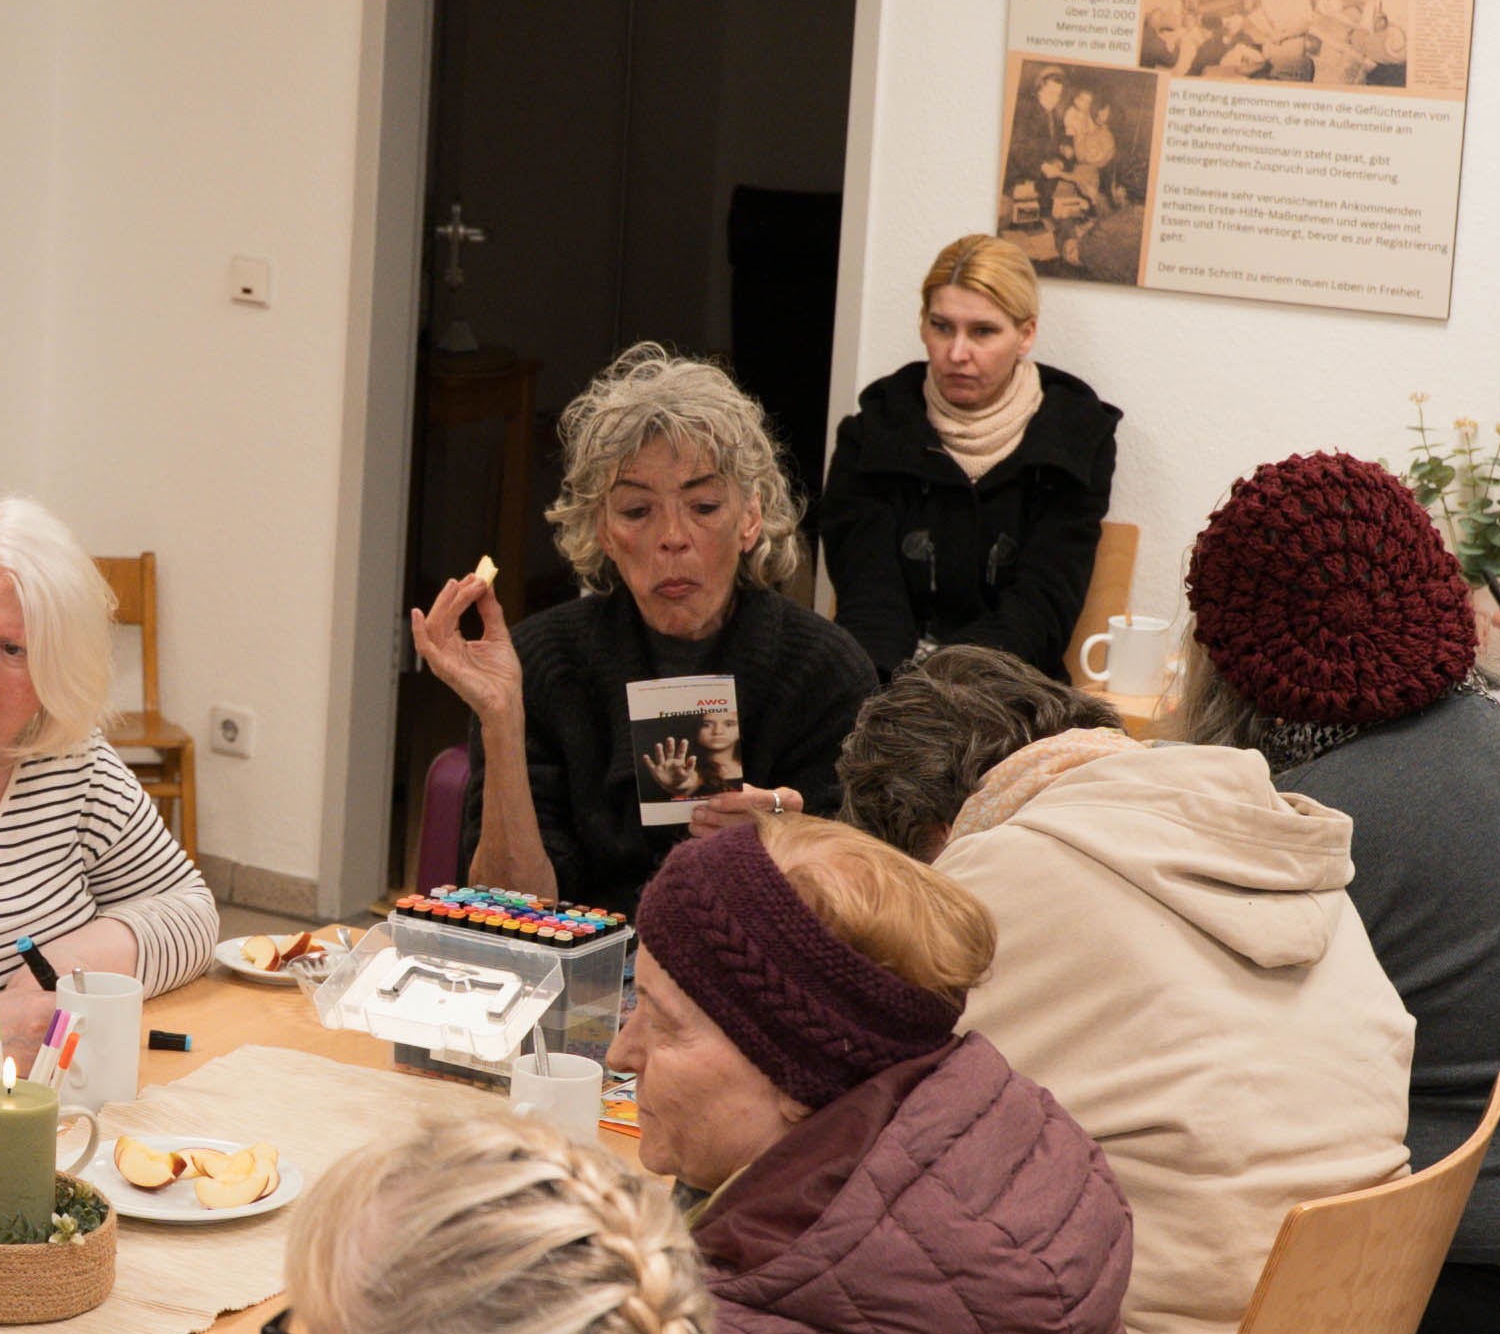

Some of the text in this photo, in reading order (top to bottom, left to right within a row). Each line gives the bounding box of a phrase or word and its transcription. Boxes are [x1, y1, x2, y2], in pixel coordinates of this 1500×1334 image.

[1157, 261, 1423, 299] Der erste Schritt zu einem neuen Leben in Freiheit.
[696, 698, 728, 707] AWO
